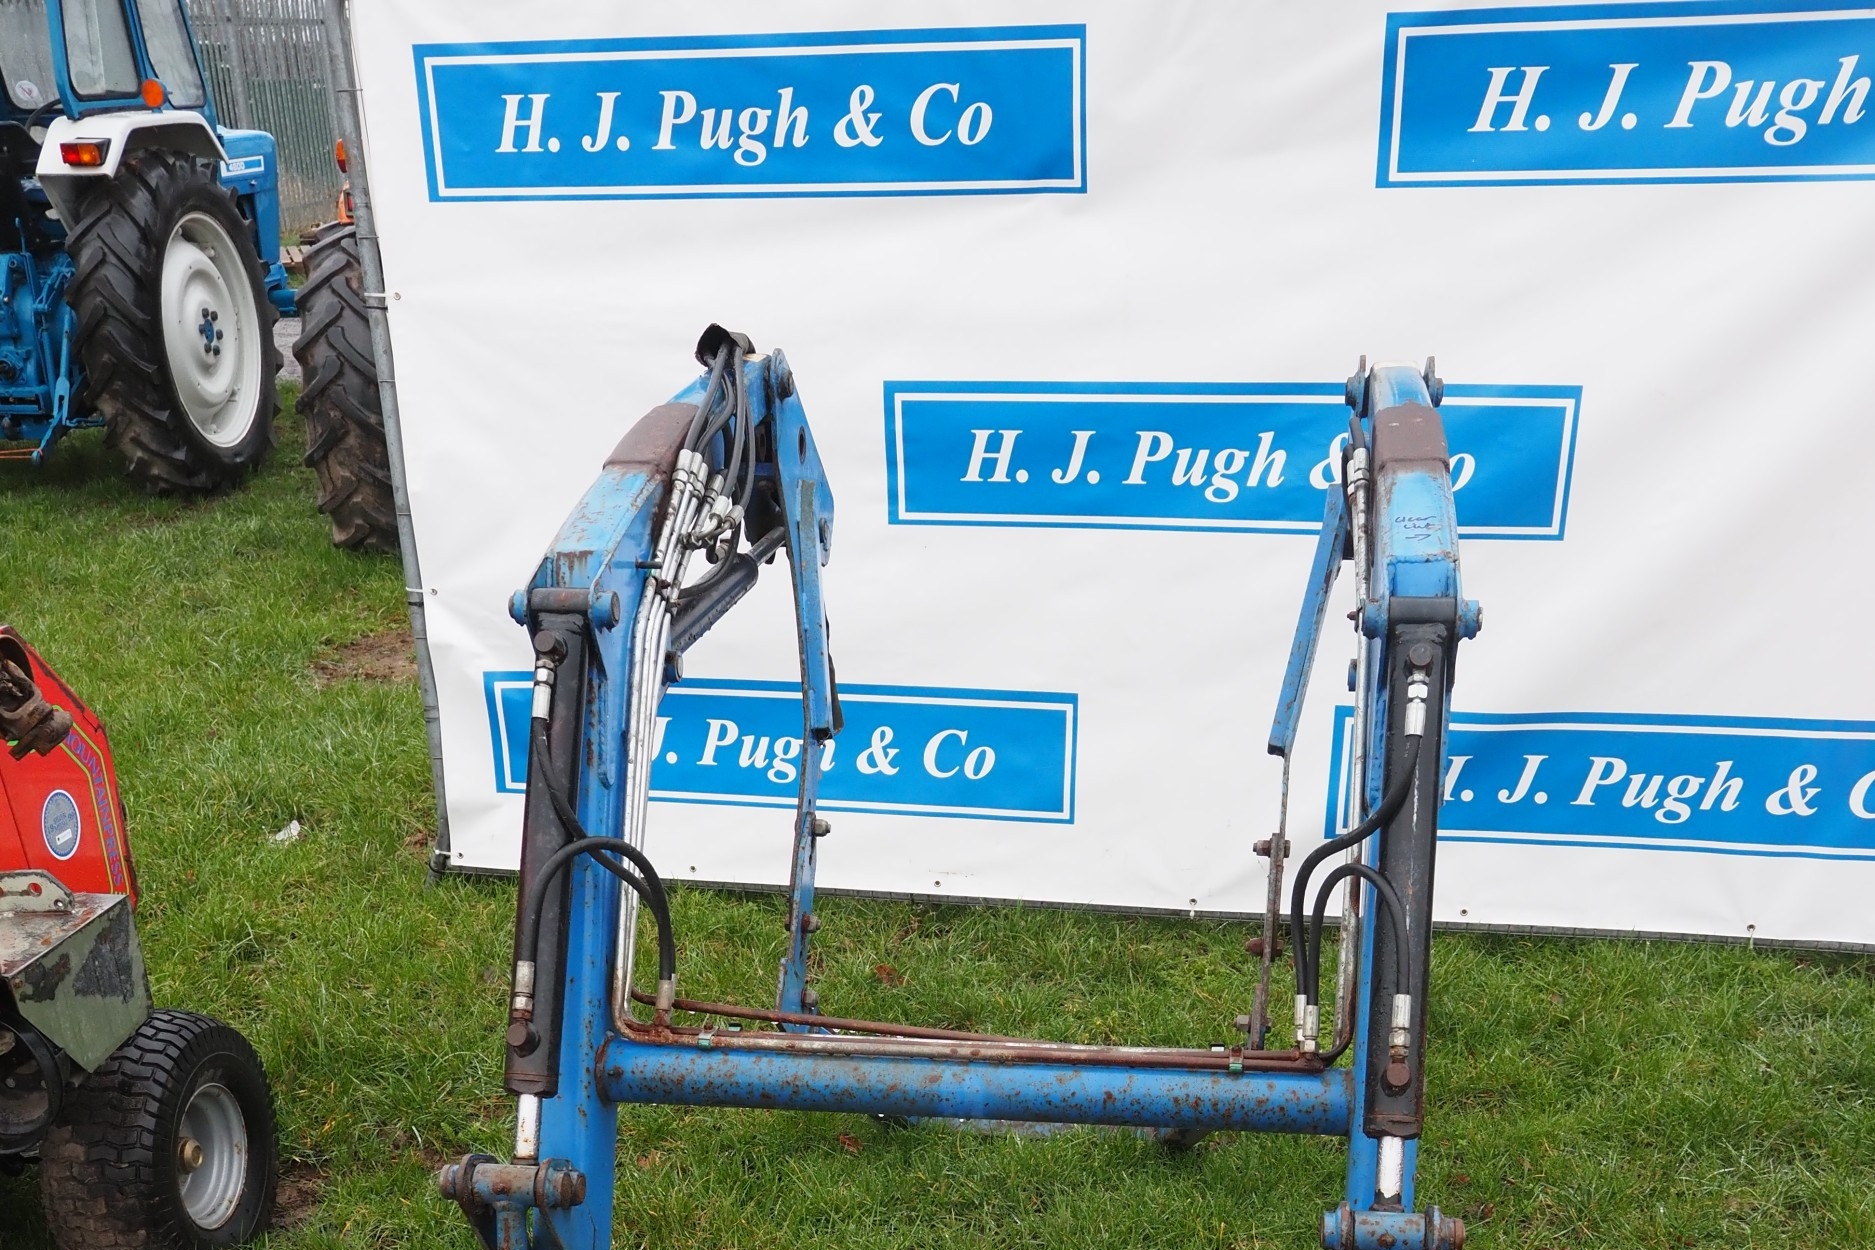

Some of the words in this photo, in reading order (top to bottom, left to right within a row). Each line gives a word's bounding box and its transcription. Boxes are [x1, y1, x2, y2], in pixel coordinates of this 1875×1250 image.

[496, 93, 560, 152] H.
[582, 92, 629, 152] J.
[652, 86, 808, 166] Pugh
[834, 84, 883, 147] &
[911, 83, 992, 146] Co
[1468, 66, 1550, 132] H.
[1579, 63, 1639, 130] J.
[1663, 54, 1871, 146] Pugh
[961, 429, 1028, 483] H.
[1052, 430, 1099, 485] J.
[1123, 431, 1286, 503] Pugh
[856, 726, 900, 776] &
[924, 729, 996, 780] Co
[1497, 755, 1549, 804] J.
[1570, 756, 1743, 824] Pugh
[1765, 764, 1821, 816] &
